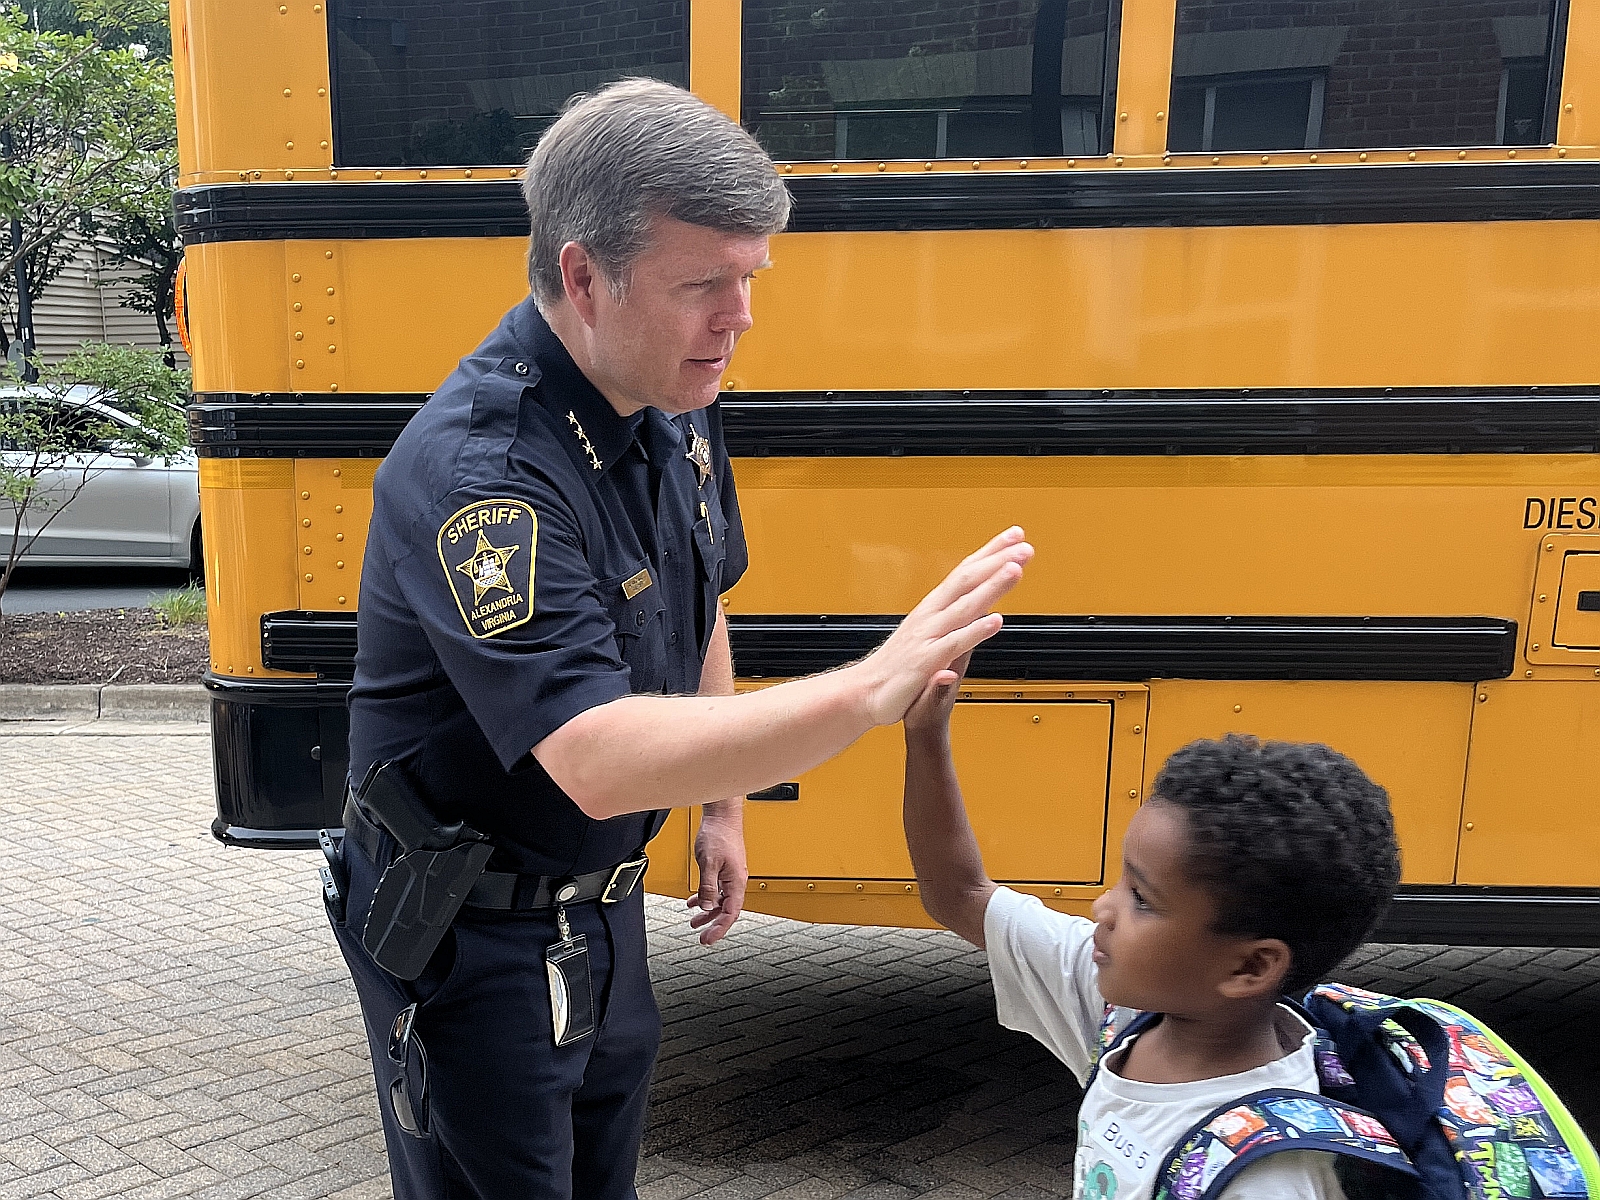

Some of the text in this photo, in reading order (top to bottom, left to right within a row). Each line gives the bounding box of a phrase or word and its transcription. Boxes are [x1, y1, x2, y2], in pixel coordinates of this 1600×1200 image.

[447, 507, 522, 545] SHERIFF
[1523, 497, 1600, 529] DIES
[470, 593, 524, 621] ALEXANDRIA
[481, 609, 517, 631] VIRGINIA
[1102, 1122, 1151, 1169] Bus 5
